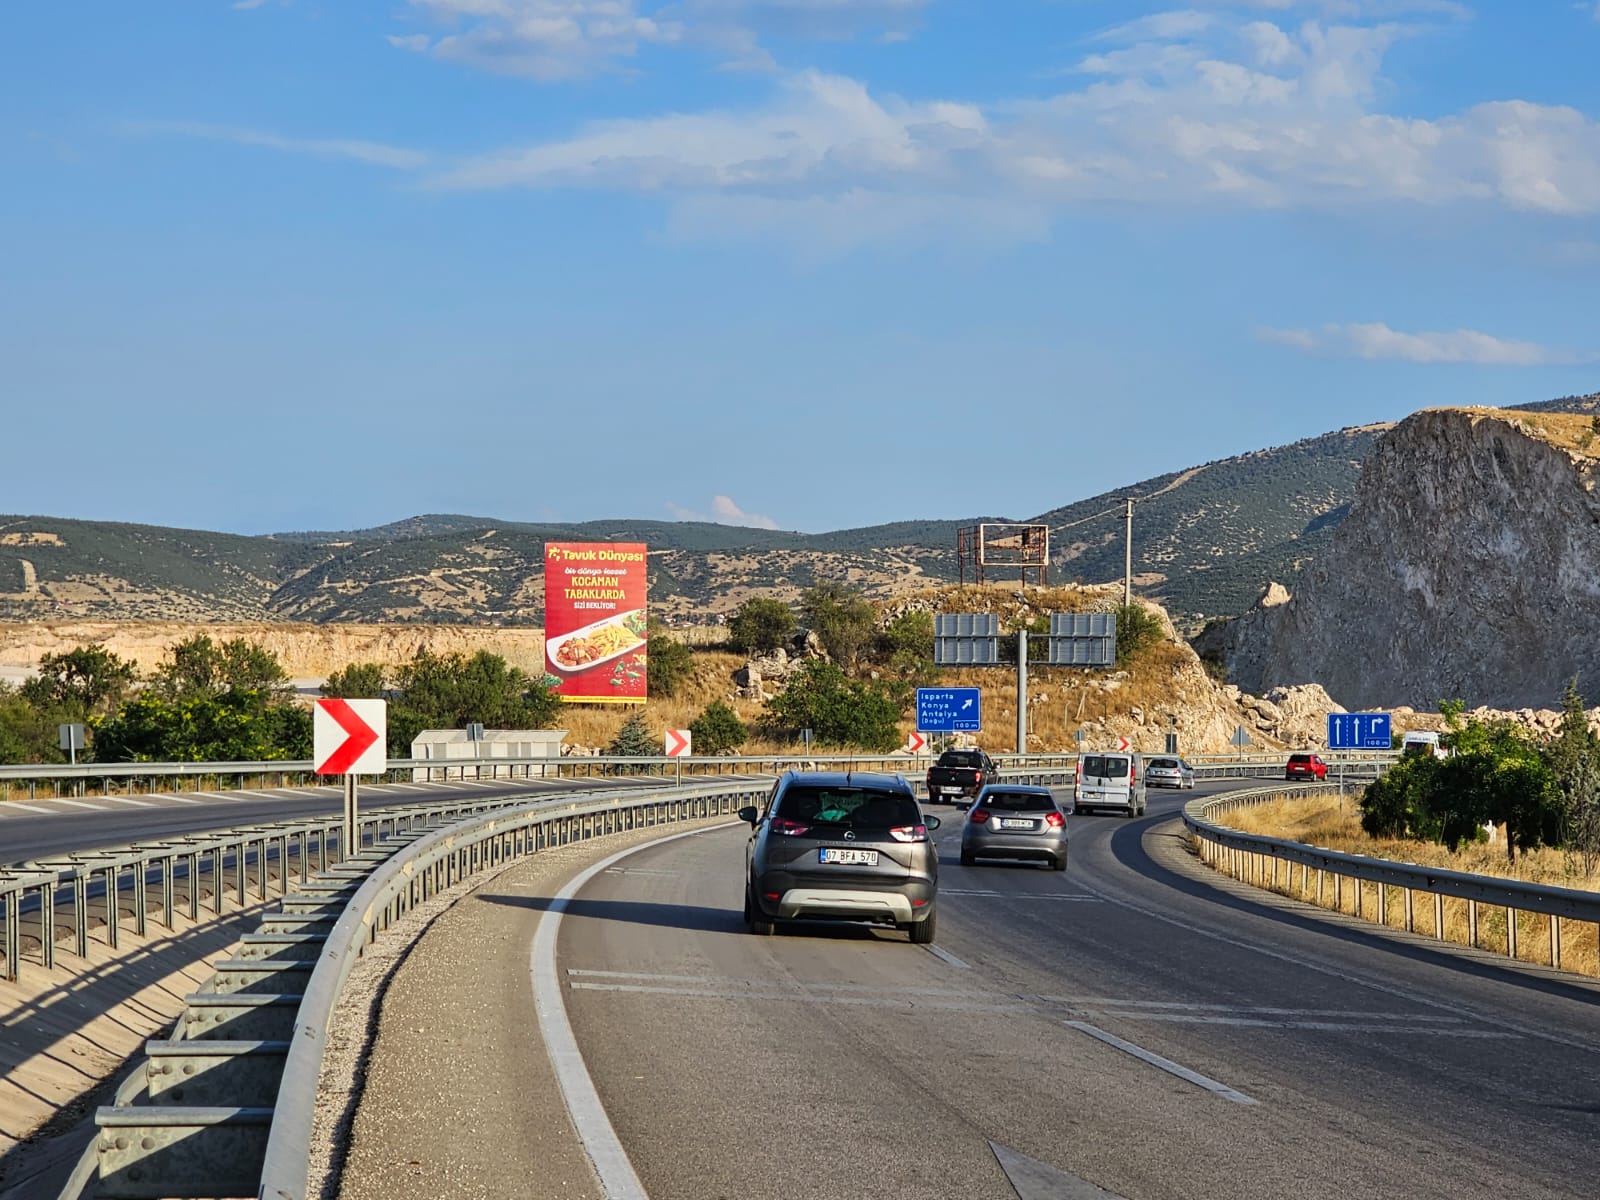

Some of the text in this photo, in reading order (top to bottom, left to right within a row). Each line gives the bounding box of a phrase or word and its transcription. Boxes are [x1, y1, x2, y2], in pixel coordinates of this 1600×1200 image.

[562, 549, 643, 563] Tavuk Dünyası
[564, 567, 577, 575] bir
[571, 576, 618, 587] KOCAMAN
[564, 588, 625, 600] TABAKLARDA
[921, 692, 954, 700] Isparta
[921, 702, 949, 710] Konya
[826, 850, 877, 862] 07 BFA 570
